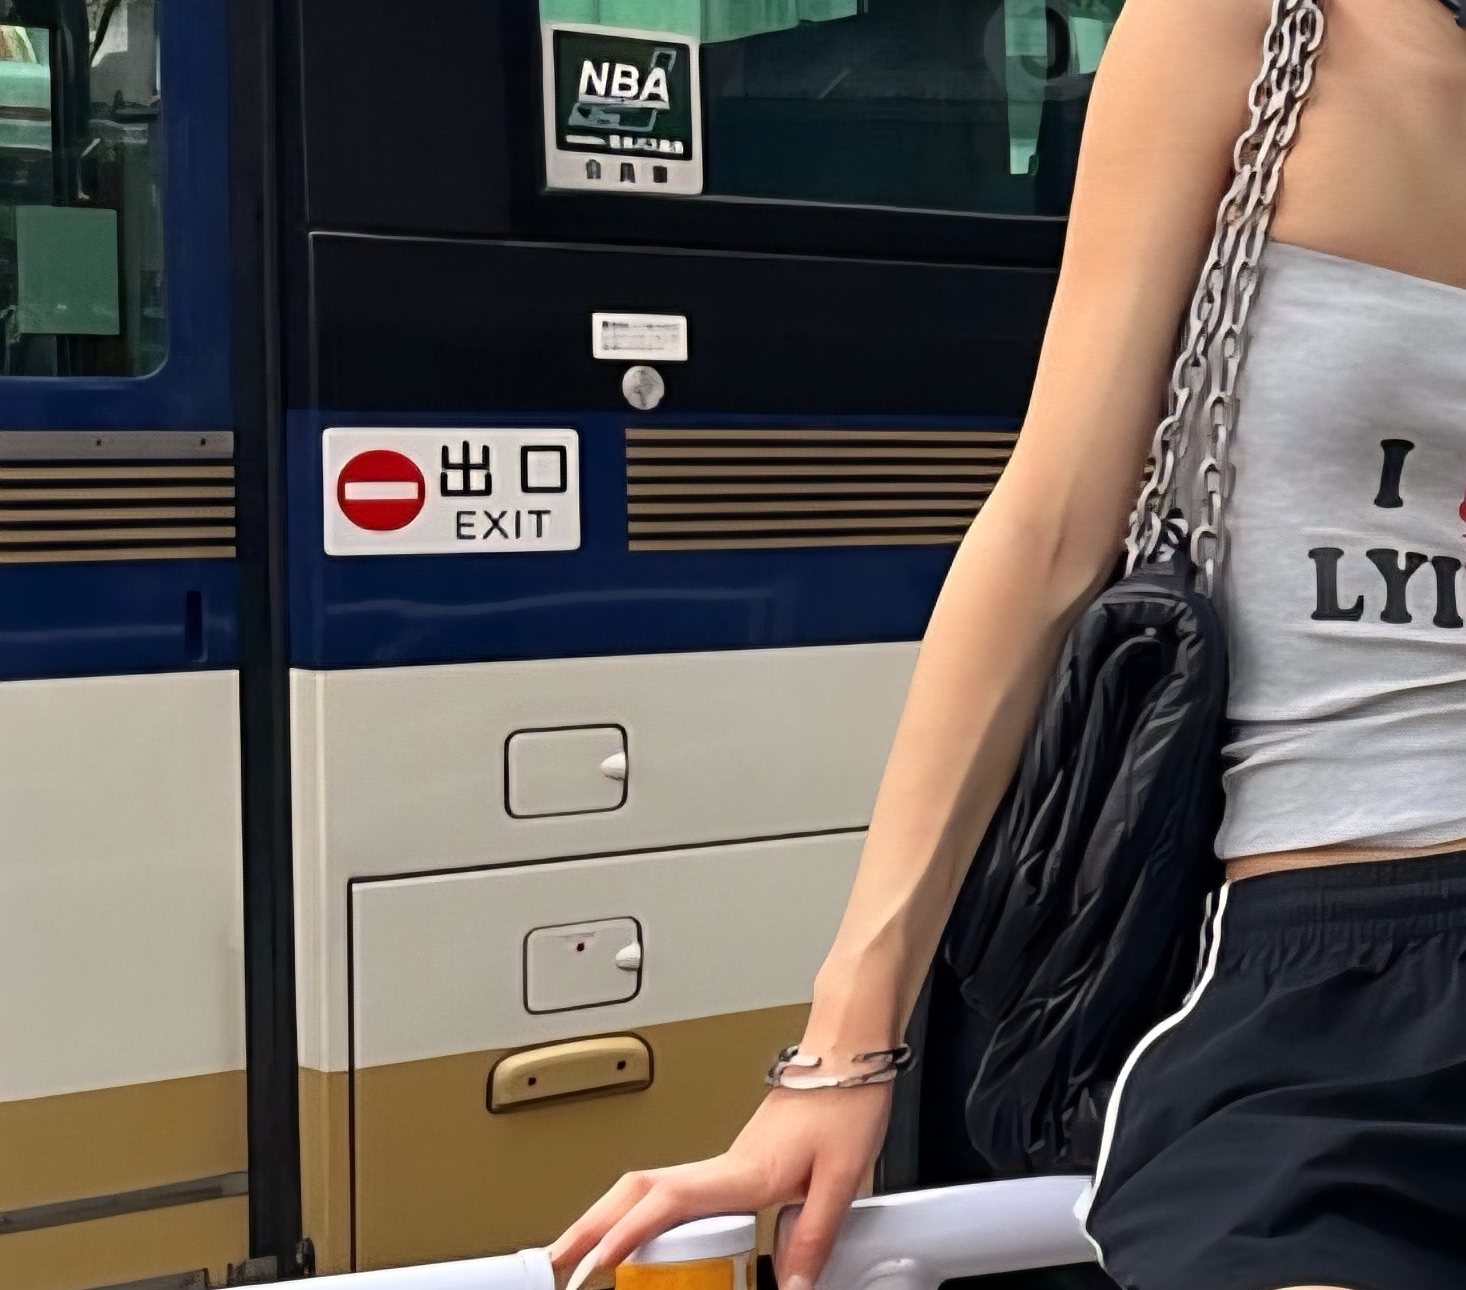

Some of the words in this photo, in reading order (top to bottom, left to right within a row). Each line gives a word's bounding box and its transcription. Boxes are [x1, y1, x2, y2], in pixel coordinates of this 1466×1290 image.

[579, 59, 670, 105] NBA
[440, 440, 568, 498] 出口
[1373, 438, 1415, 509] I
[456, 510, 552, 540] EXIT
